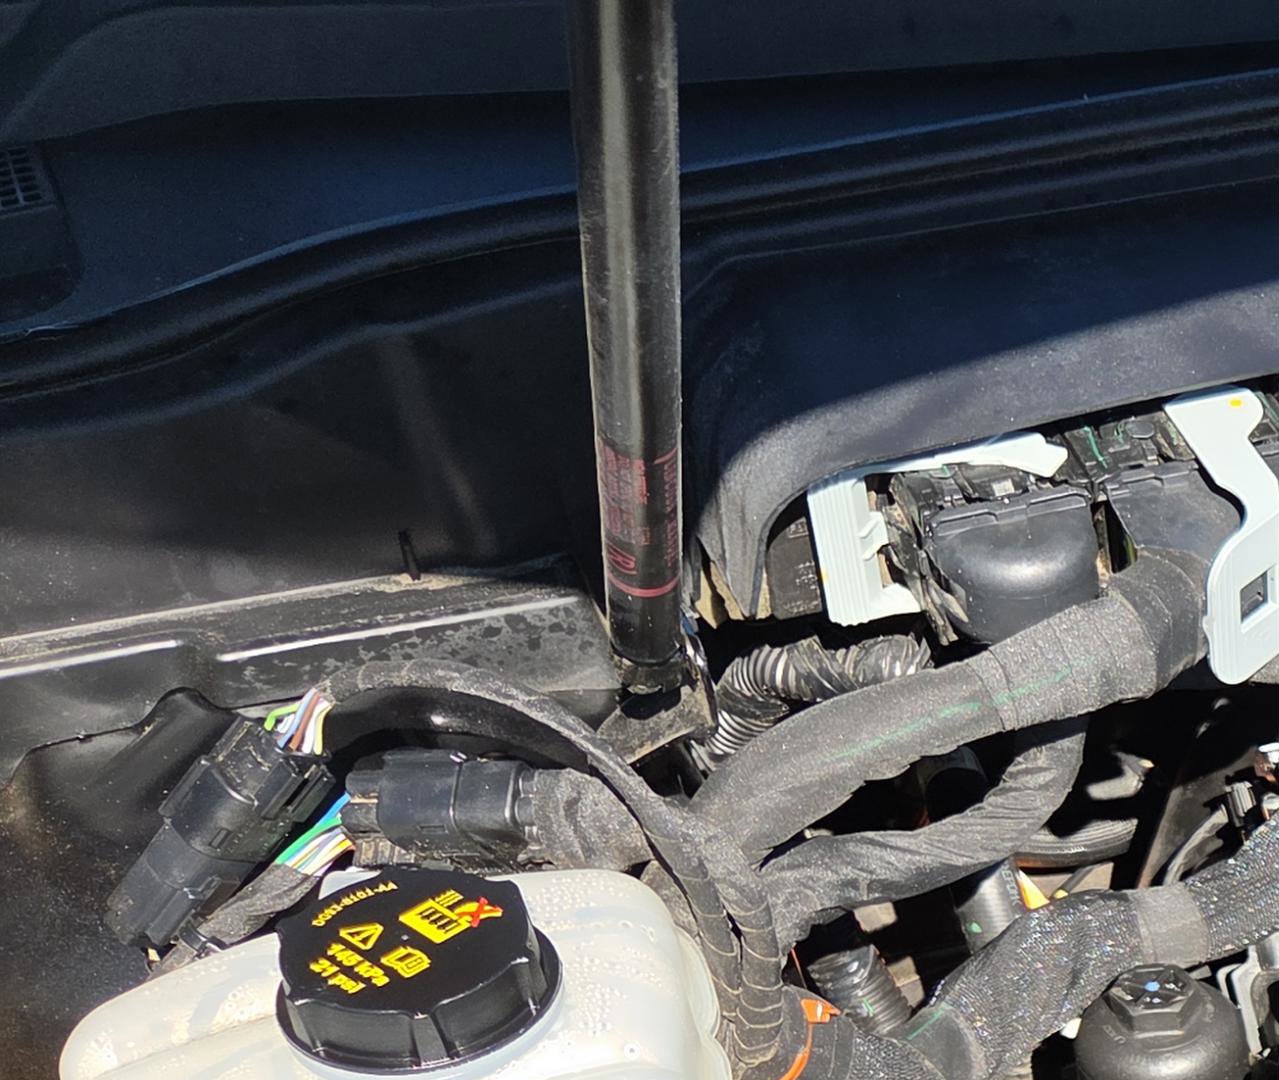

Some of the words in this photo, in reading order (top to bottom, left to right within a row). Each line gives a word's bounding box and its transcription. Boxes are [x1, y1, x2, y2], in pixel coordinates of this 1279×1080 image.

[310, 957, 339, 976] 21
[328, 972, 365, 993] psi
[327, 943, 363, 965] 145
[354, 960, 389, 986] kPa
